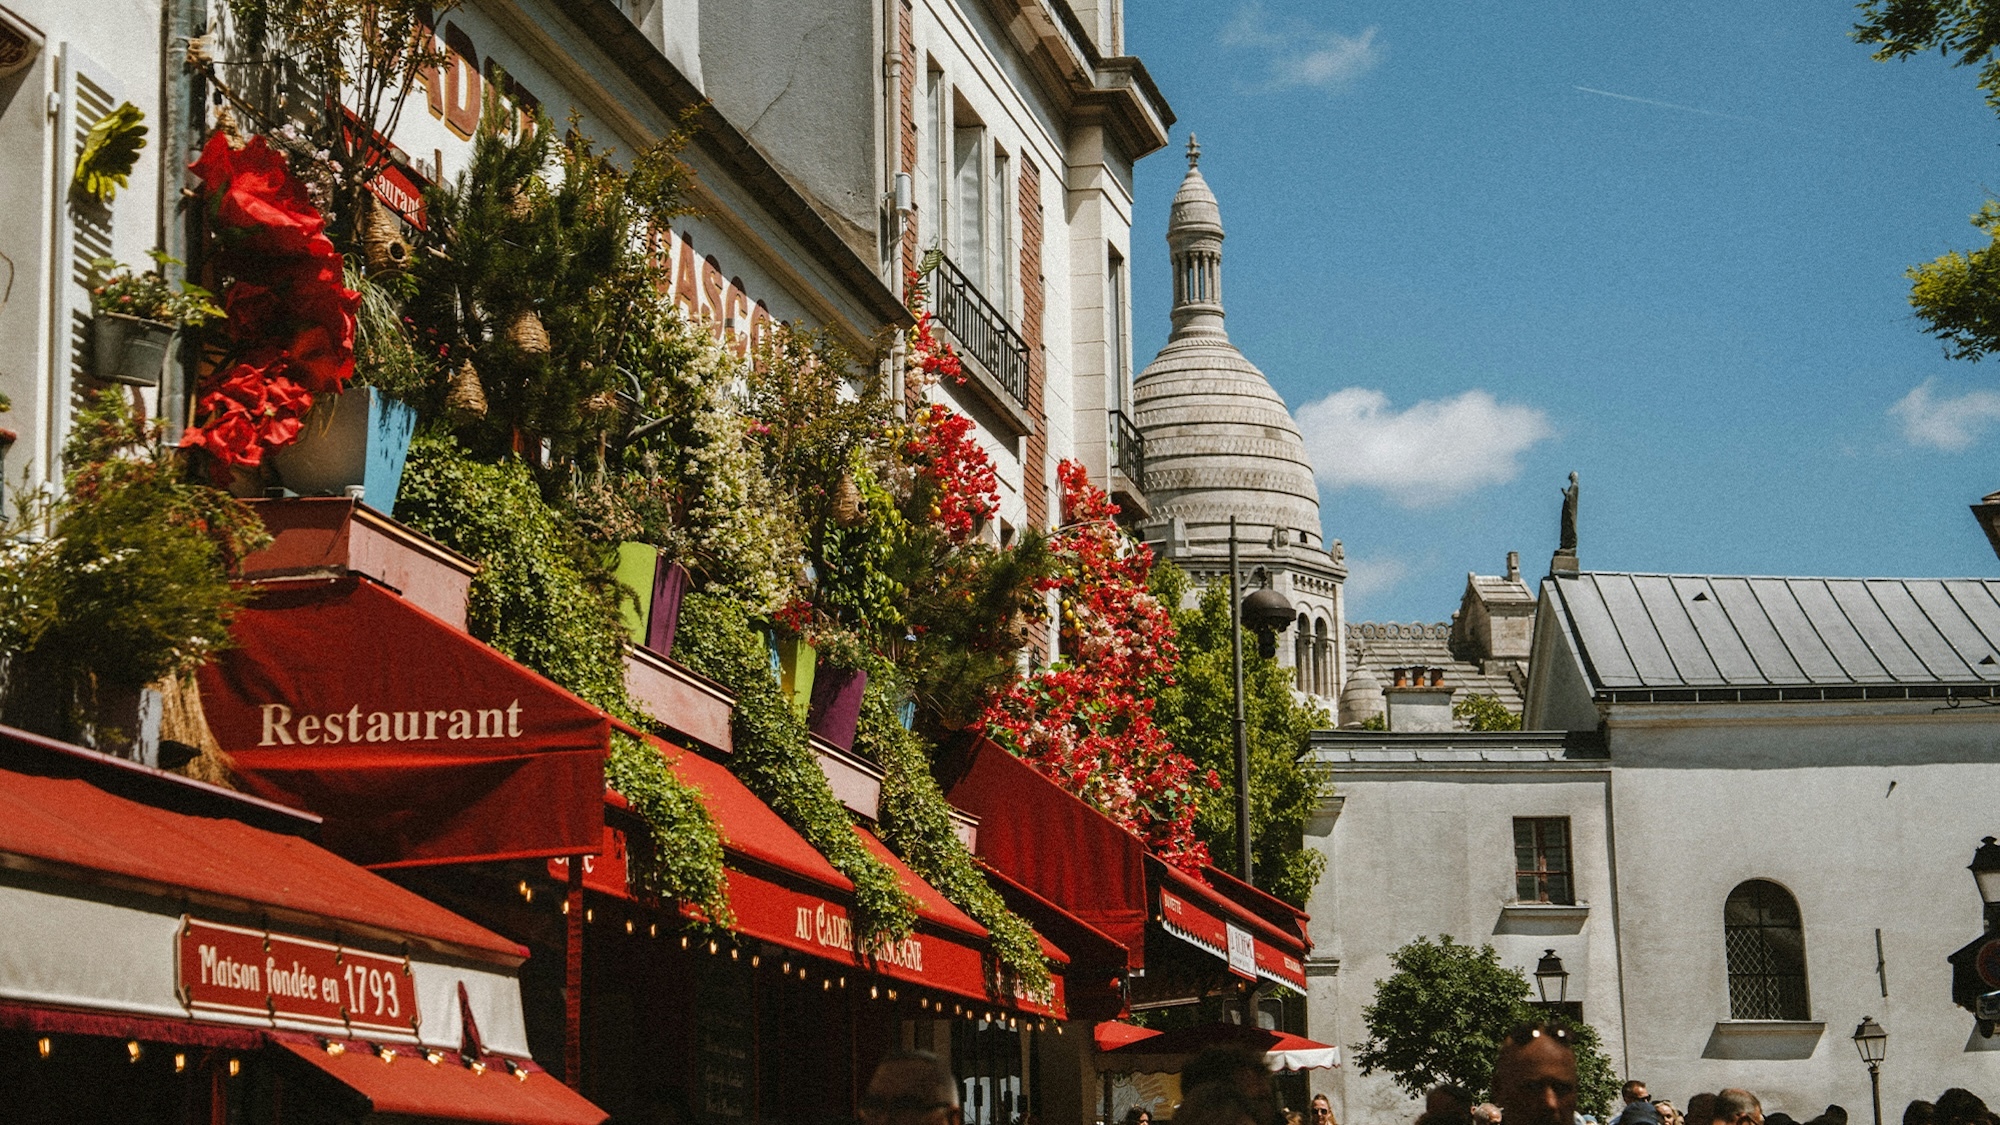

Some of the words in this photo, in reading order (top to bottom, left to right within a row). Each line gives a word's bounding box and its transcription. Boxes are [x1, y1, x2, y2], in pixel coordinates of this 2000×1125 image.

[257, 698, 524, 746] Restaurant
[795, 906, 813, 941] AU
[198, 944, 261, 993] Maison
[265, 956, 318, 1001] fondée
[321, 976, 341, 1005] en
[343, 963, 400, 1018] 1793
